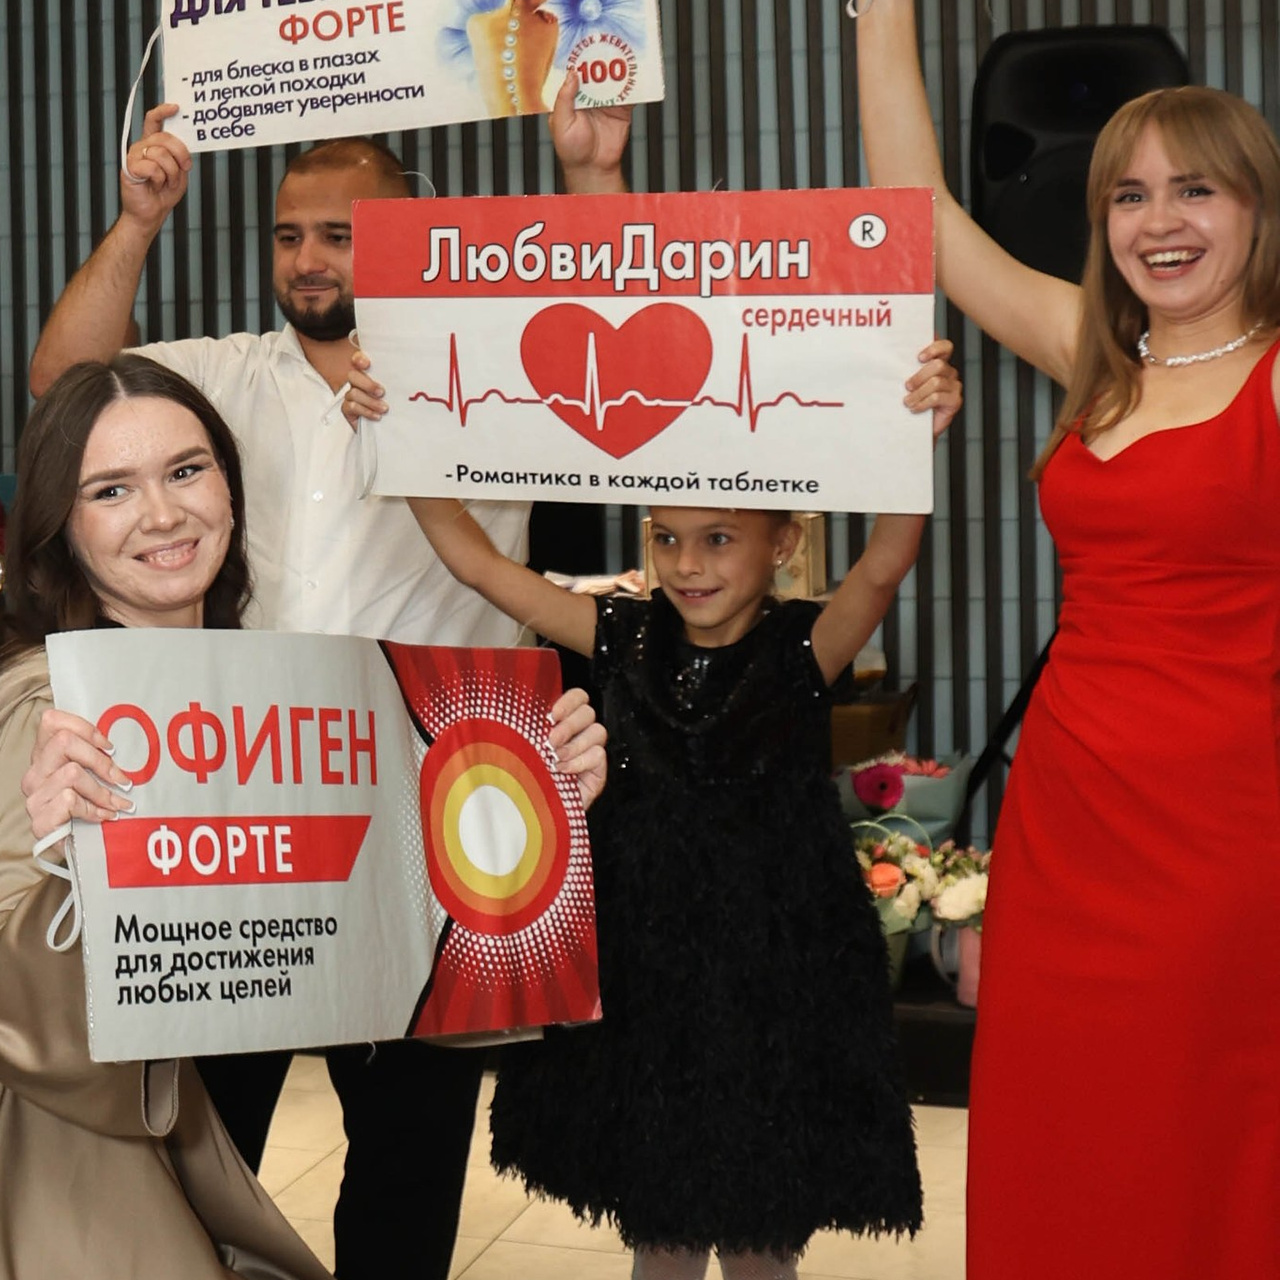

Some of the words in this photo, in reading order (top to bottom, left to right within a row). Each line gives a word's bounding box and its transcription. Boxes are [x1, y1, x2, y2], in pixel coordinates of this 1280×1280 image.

[278, 0, 406, 46] ФОРТЕ
[192, 69, 223, 88] для
[227, 59, 295, 81] блеска
[299, 58, 309, 71] в
[313, 49, 380, 70] глазах
[576, 57, 627, 85] 100
[193, 98, 294, 125] добавляет
[298, 84, 426, 118] уверенности
[194, 90, 206, 103] и
[210, 77, 276, 102] легкой
[280, 71, 366, 94] походки
[197, 128, 207, 141] в
[211, 119, 256, 139] себе
[422, 221, 812, 297] ЛюбвиДарин
[742, 300, 893, 335] сердечный
[589, 474, 600, 487] в
[608, 472, 700, 491] каждой
[708, 471, 820, 493] таблетке
[95, 701, 379, 787] ОФИГЕН
[146, 823, 294, 876] ФОРТЕ
[114, 914, 233, 946] Мощное
[239, 916, 338, 947] средство
[115, 953, 162, 979] для
[170, 947, 315, 976] достижения
[117, 971, 213, 1005] любых
[220, 969, 292, 1004] целей
